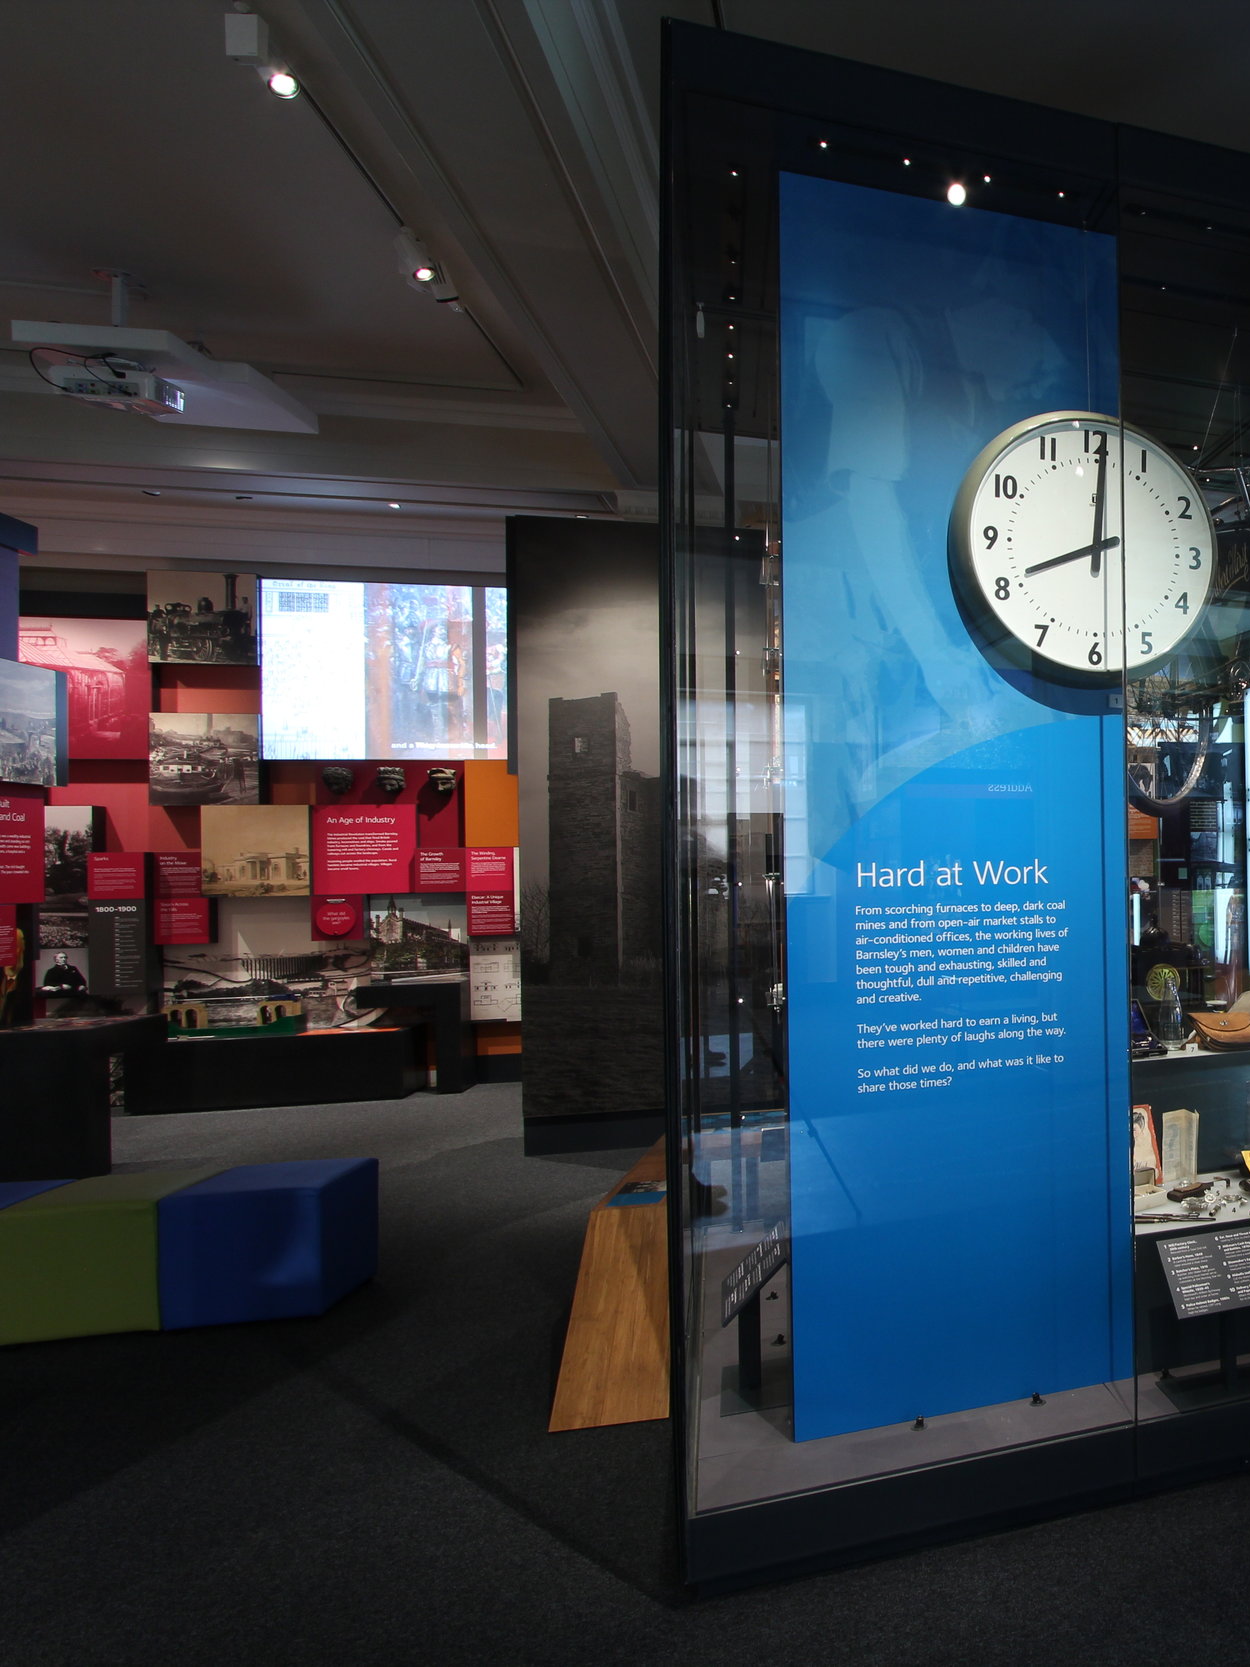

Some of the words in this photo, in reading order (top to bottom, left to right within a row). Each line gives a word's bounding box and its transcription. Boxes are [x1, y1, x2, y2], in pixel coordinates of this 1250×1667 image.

[1040, 436, 1056, 461] 11
[1084, 430, 1108, 456] 12
[1141, 449, 1146, 472] 1
[994, 474, 1017, 500] 10
[1177, 496, 1192, 520] 2
[983, 526, 998, 550] 9
[1188, 546, 1202, 570] 3
[995, 576, 1010, 600] 8
[1174, 592, 1189, 614] 4
[1034, 624, 1049, 648] 7
[1141, 632, 1152, 654] 5
[1088, 642, 1102, 666] 6
[12, 813, 25, 822] Coal
[339, 817, 353, 825] Age
[365, 817, 395, 825] Industry
[858, 860, 924, 887] Hard
[937, 863, 962, 886] at
[973, 859, 1048, 885] Work
[856, 906, 882, 915] From
[885, 904, 933, 916] scorching
[936, 903, 978, 912] furnaces
[994, 902, 1020, 913] deep,
[1023, 901, 1043, 910] dark
[1047, 900, 1065, 909] coal
[856, 921, 885, 930] mines
[889, 919, 907, 929] and
[911, 918, 935, 928] from
[938, 917, 980, 929] open-air
[984, 916, 1017, 925] market
[1020, 915, 1043, 924] stalls
[856, 933, 933, 945] air-conditioned
[936, 932, 972, 942] offices,
[975, 931, 991, 940] the
[994, 930, 1032, 941] working
[1036, 929, 1055, 937] lives
[1058, 928, 1068, 937] of
[856, 949, 906, 961] Barnsley's
[938, 948, 974, 956] women
[977, 945, 994, 954] and
[998, 944, 1034, 953] children
[1038, 943, 1059, 951] have
[856, 965, 881, 974] been
[885, 963, 914, 975] tough
[918, 962, 936, 971] and
[939, 960, 994, 971] exhausting,
[998, 958, 1026, 968] skilled
[1029, 957, 1046, 966] and
[856, 978, 913, 991] thoughtful,
[917, 977, 934, 986] dull
[938, 976, 956, 985] and
[958, 974, 1007, 985] repetitive,
[1010, 971, 1062, 982] challenging
[857, 994, 875, 1004] and
[879, 993, 921, 1003] creative.
[857, 1023, 897, 1035] They've
[900, 1020, 937, 1031] worked
[941, 1019, 962, 1028] hard
[1012, 1014, 1038, 1025] living,
[1042, 1013, 1057, 1021] but
[857, 1039, 885, 1048] there
[888, 1038, 913, 1046] were
[917, 1035, 948, 1047] plenty
[951, 1033, 961, 1042] of
[965, 1031, 995, 1042] laughs
[998, 1030, 1024, 1040] along
[1027, 1028, 1042, 1036] the
[1045, 1028, 1065, 1037] way.
[858, 1069, 871, 1078] So
[874, 1067, 899, 1077] what
[903, 1065, 918, 1074] did
[939, 1062, 954, 1072] do,
[958, 1060, 975, 1070] and
[978, 1059, 1002, 1068] what
[1036, 1055, 1051, 1064] like
[858, 1083, 885, 1093] share
[889, 1081, 917, 1090] those
[920, 1077, 952, 1088] times?
